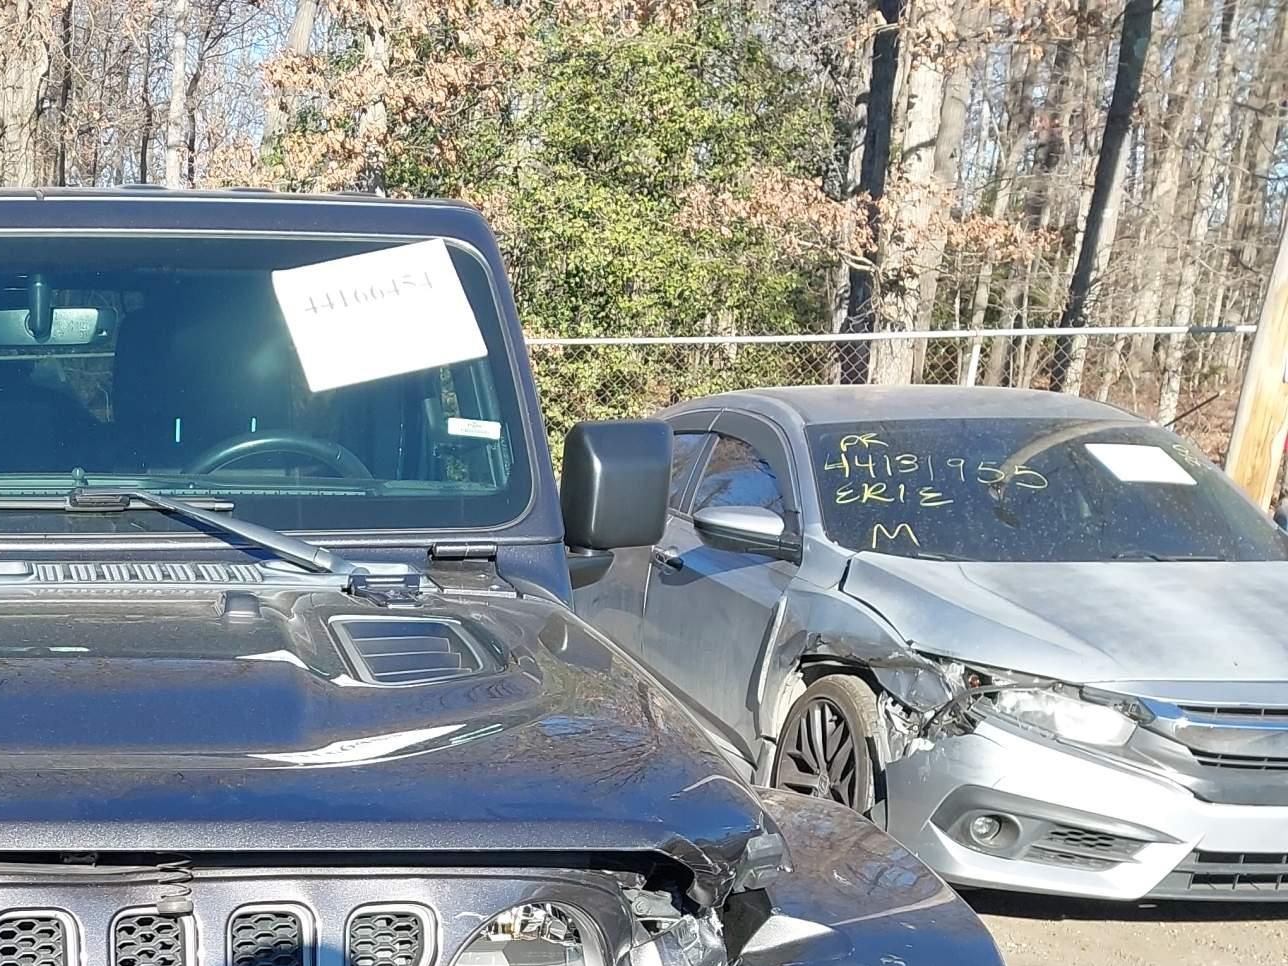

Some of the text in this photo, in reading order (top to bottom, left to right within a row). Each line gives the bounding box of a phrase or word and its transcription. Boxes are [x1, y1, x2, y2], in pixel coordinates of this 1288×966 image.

[823, 453, 1049, 490] 44131955
[835, 482, 954, 507] ERIE
[871, 522, 921, 550] M
